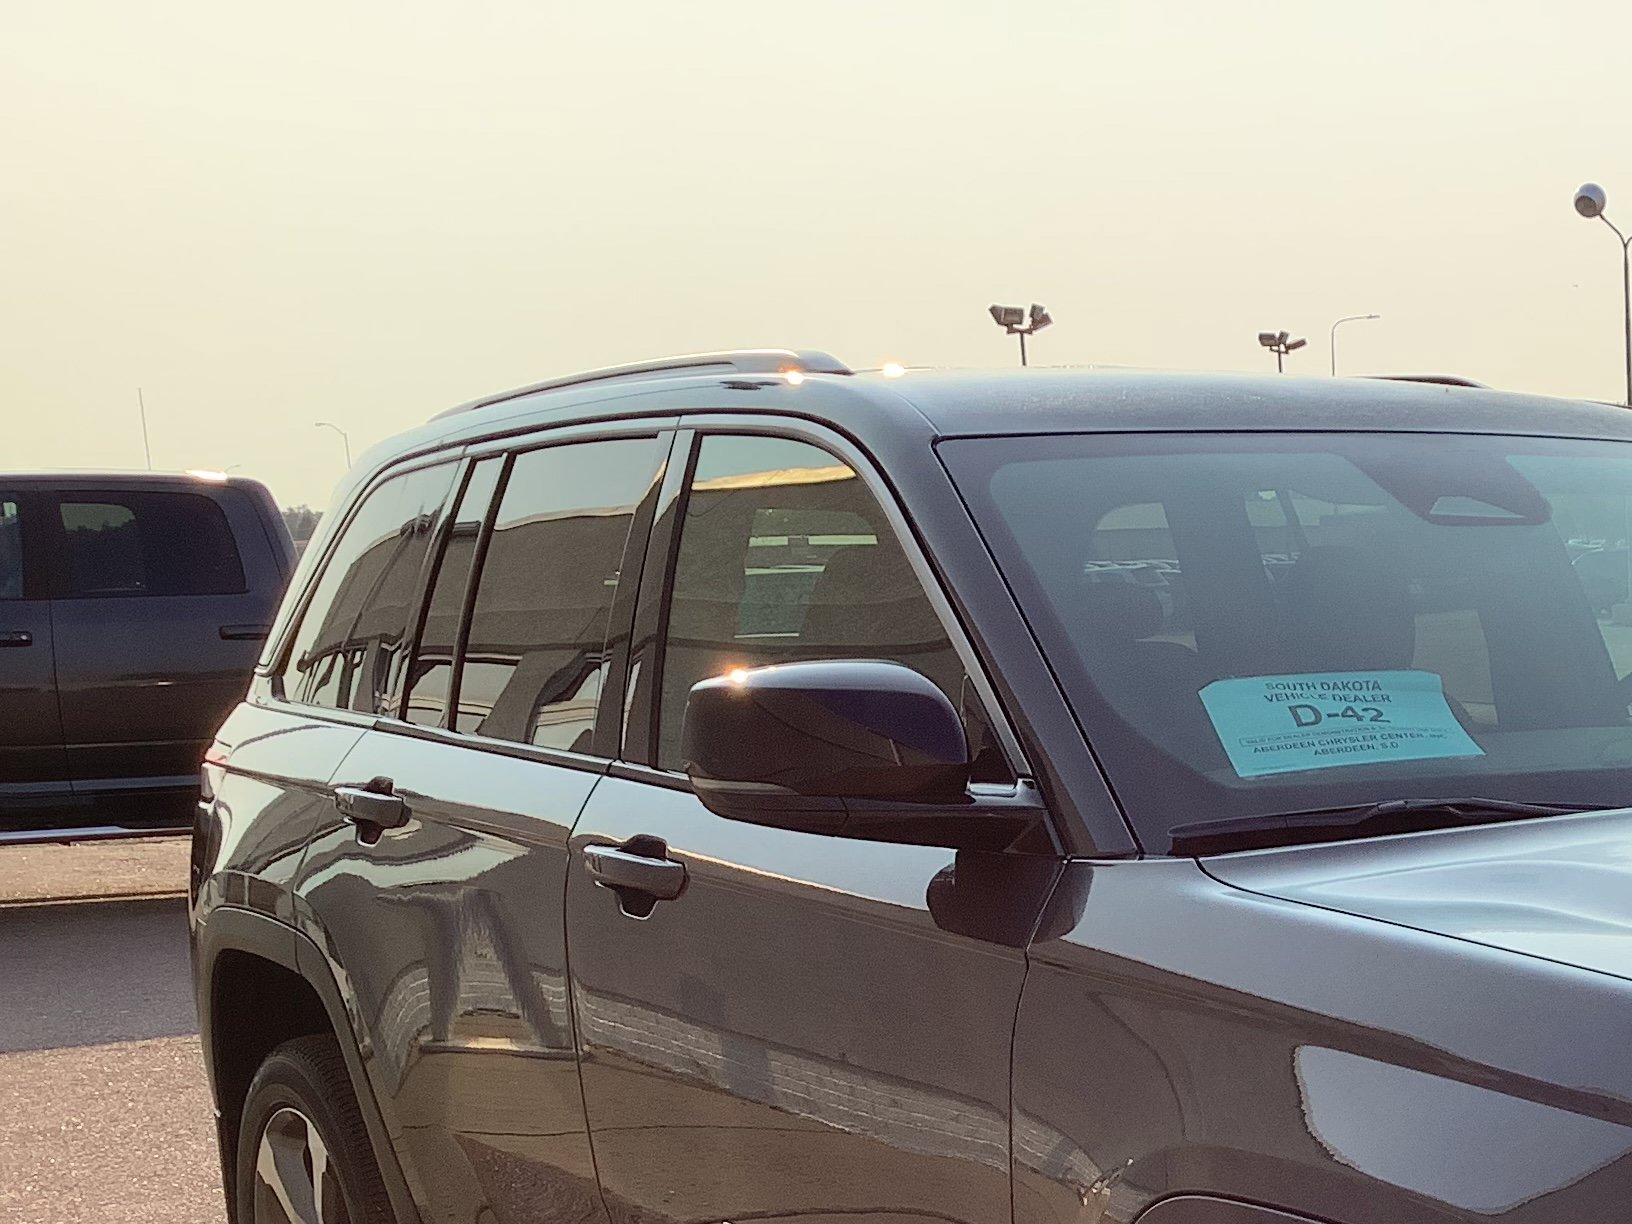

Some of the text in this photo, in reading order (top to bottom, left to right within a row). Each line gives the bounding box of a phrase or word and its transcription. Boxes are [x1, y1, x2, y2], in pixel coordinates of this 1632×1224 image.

[1264, 680, 1382, 692] SOUTH DAKOTA
[1263, 691, 1393, 703] VEHICLE DEALER
[1287, 703, 1392, 728] D-42
[1253, 740, 1316, 754] ABERDEEN
[1318, 734, 1378, 747] CHRYSLER
